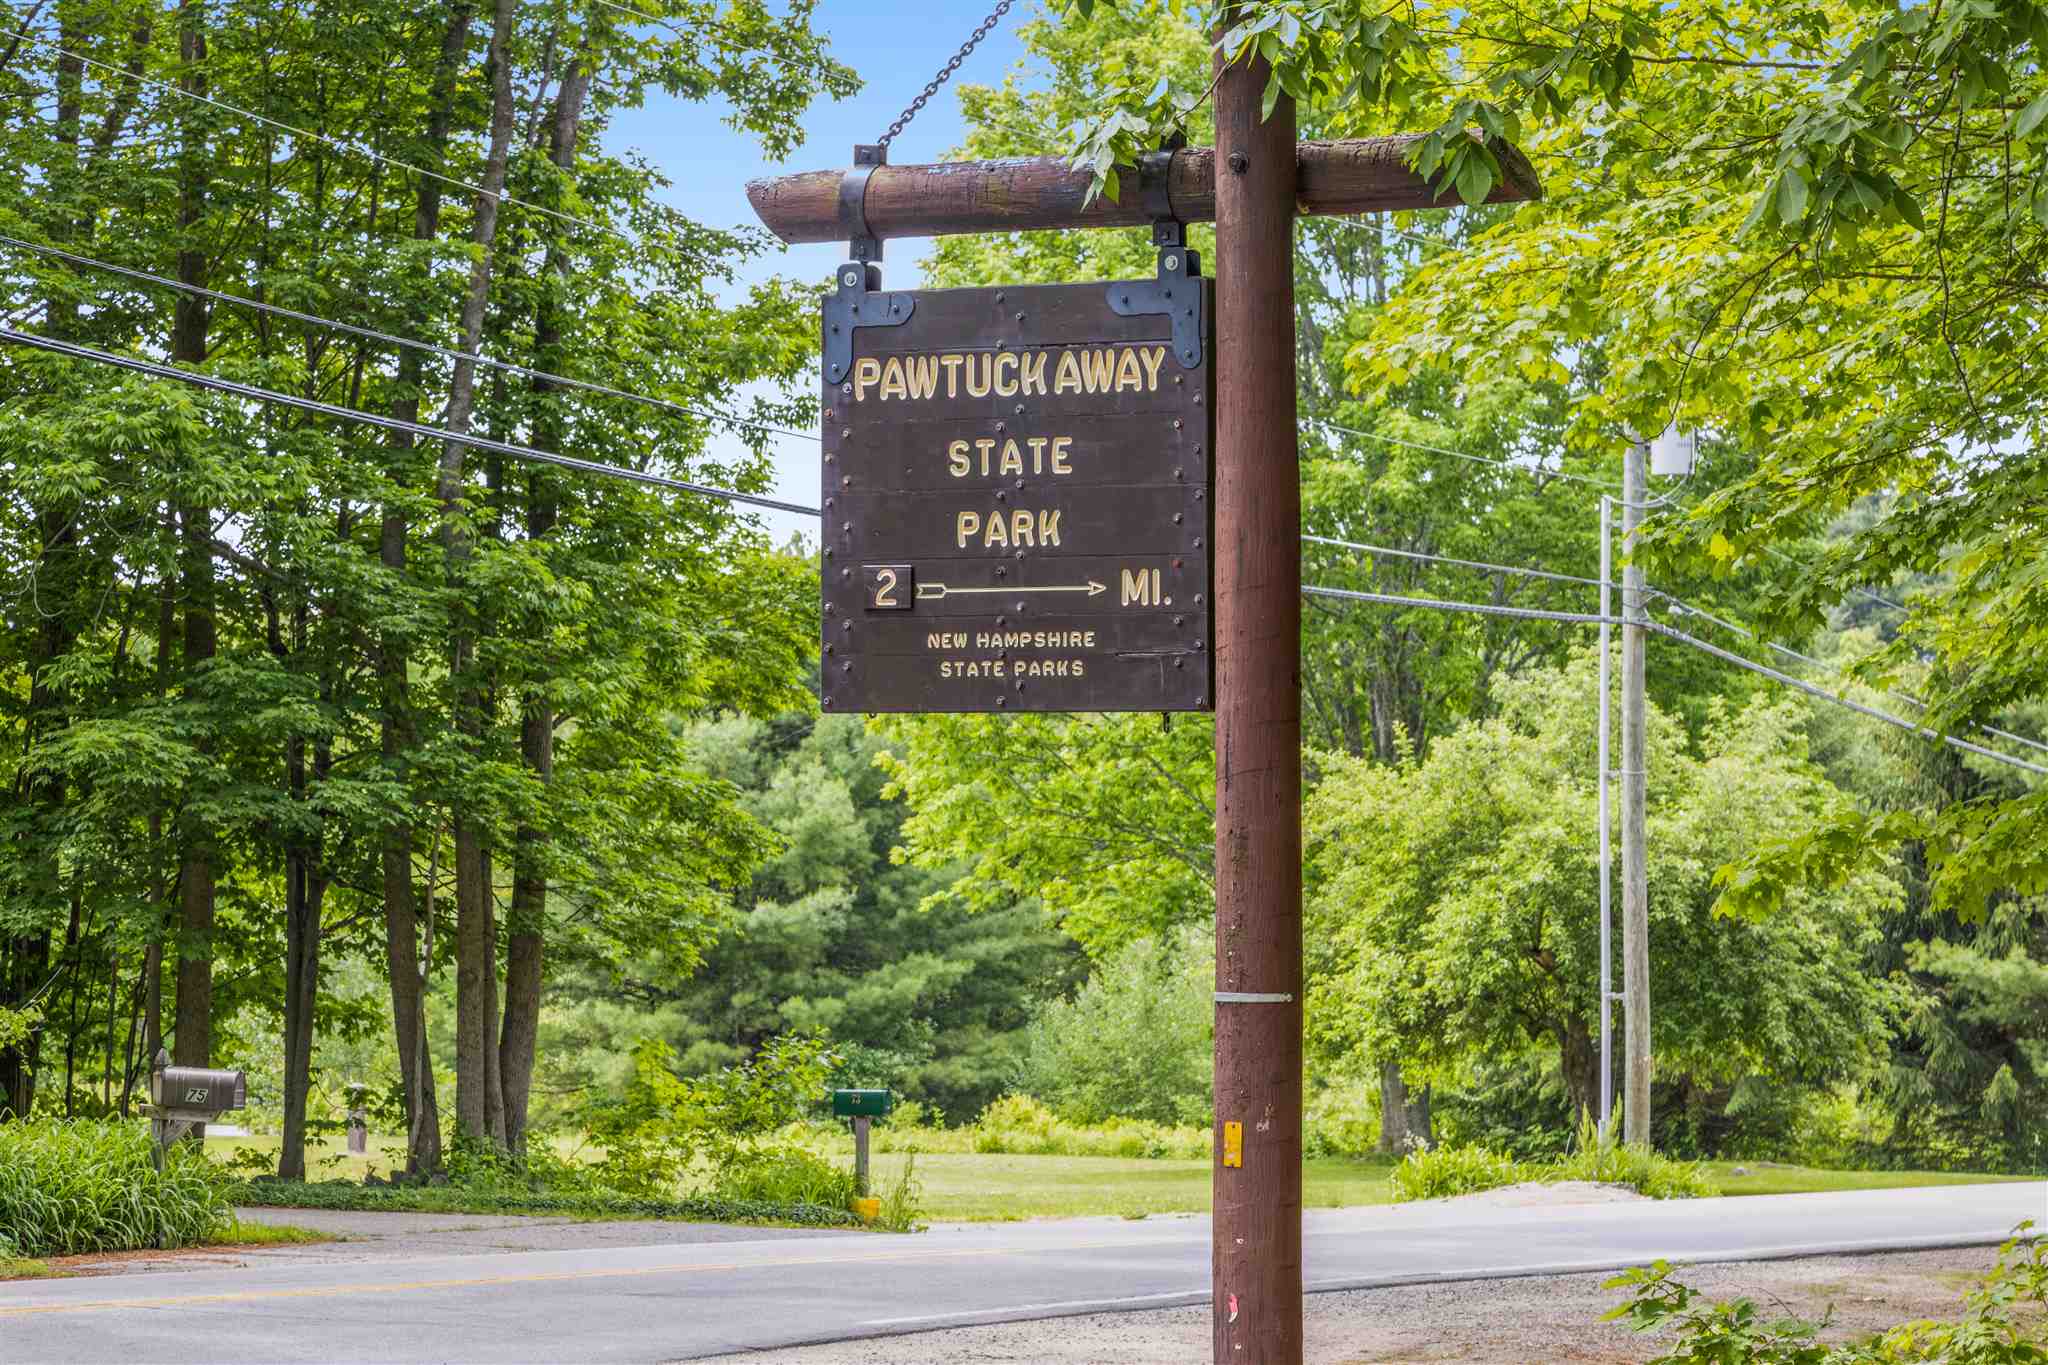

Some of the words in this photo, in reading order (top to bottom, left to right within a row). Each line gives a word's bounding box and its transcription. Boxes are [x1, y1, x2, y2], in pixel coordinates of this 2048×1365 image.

[855, 346, 1166, 401] PAWTUCKAWAY
[949, 437, 1073, 477] STATE
[957, 510, 1061, 548] PARK
[875, 569, 897, 606] 2
[1121, 568, 1172, 606] MI.
[927, 632, 968, 648] NEW
[976, 631, 1096, 648] HAMPSHIRE
[940, 661, 1004, 677] STATE
[1014, 660, 1085, 677] PARKS
[185, 1088, 209, 1103] 75
